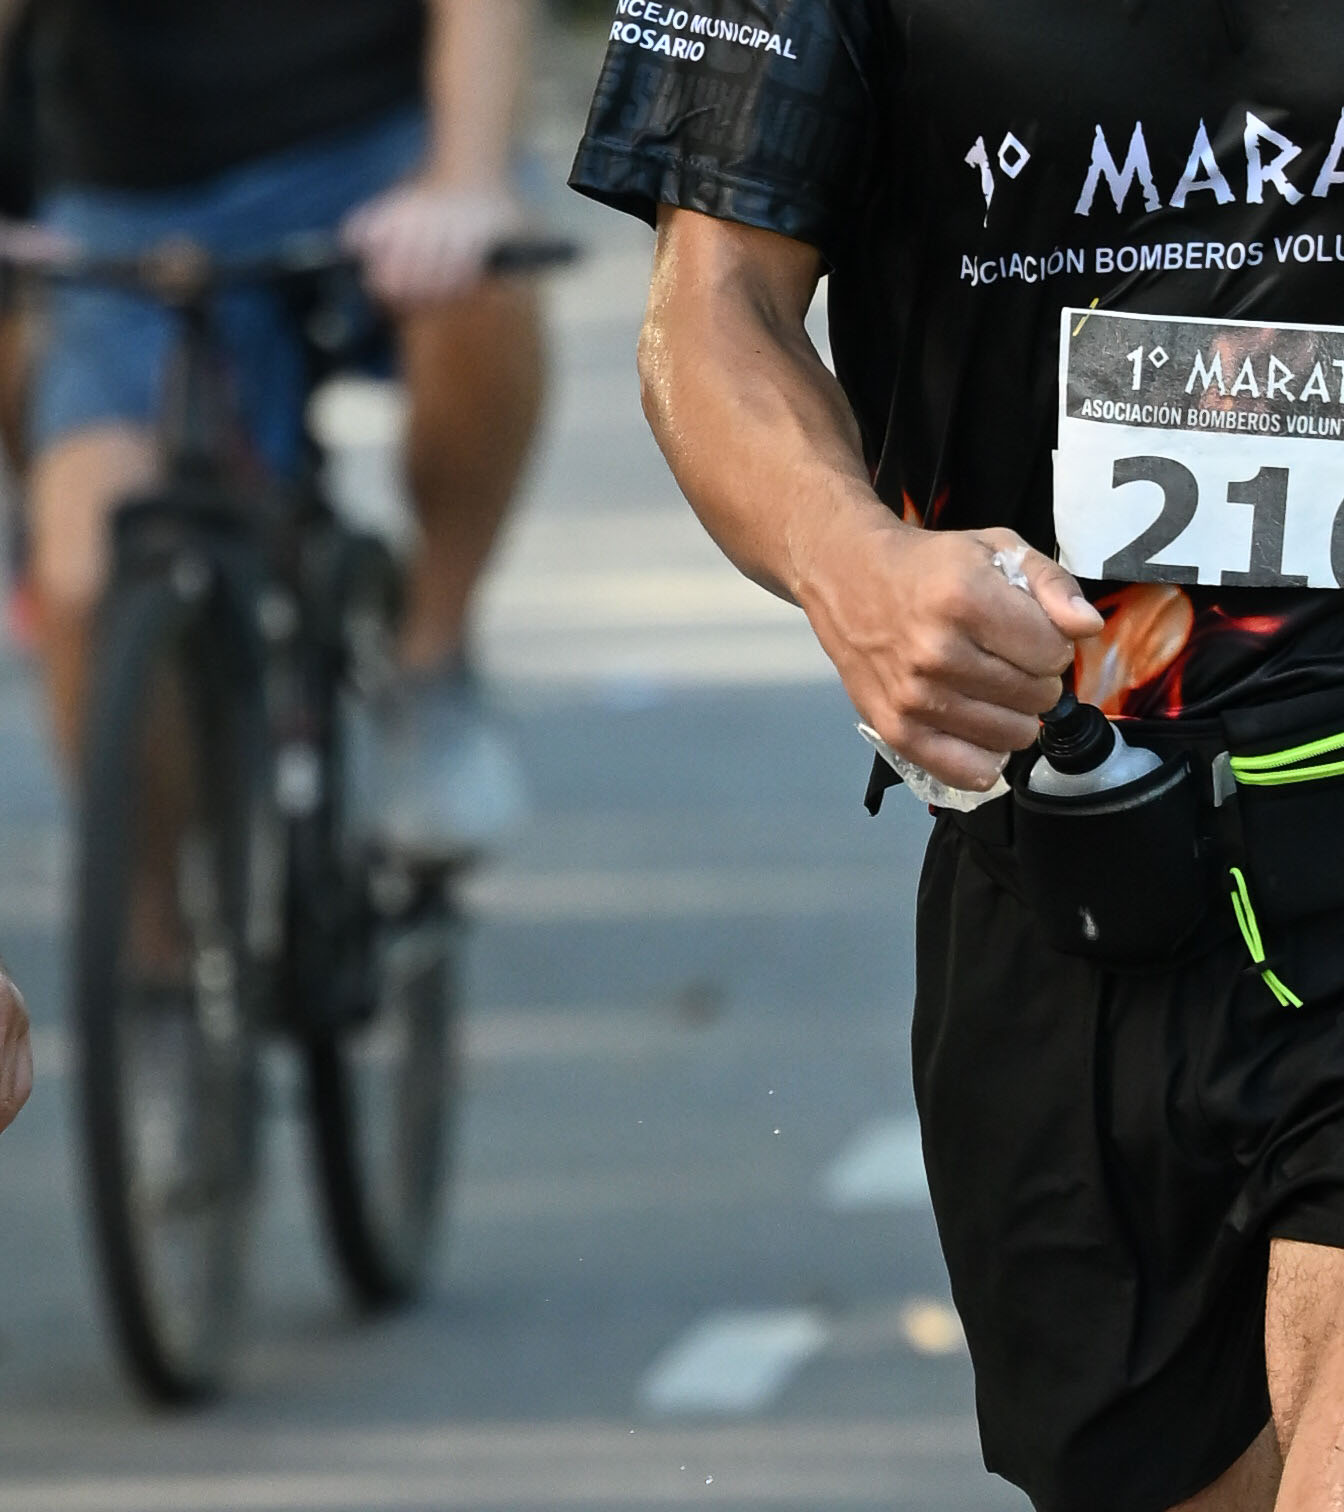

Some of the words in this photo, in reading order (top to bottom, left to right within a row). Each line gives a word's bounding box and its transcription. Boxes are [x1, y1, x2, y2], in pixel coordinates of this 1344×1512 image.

[609, 21, 705, 62] ROSARIO
[690, 14, 797, 60] MUNICIPAL
[1095, 240, 1264, 274] BOMBEROS
[1081, 399, 1181, 427] ASOCIACIÓN
[1187, 408, 1281, 433] BOMBEROS
